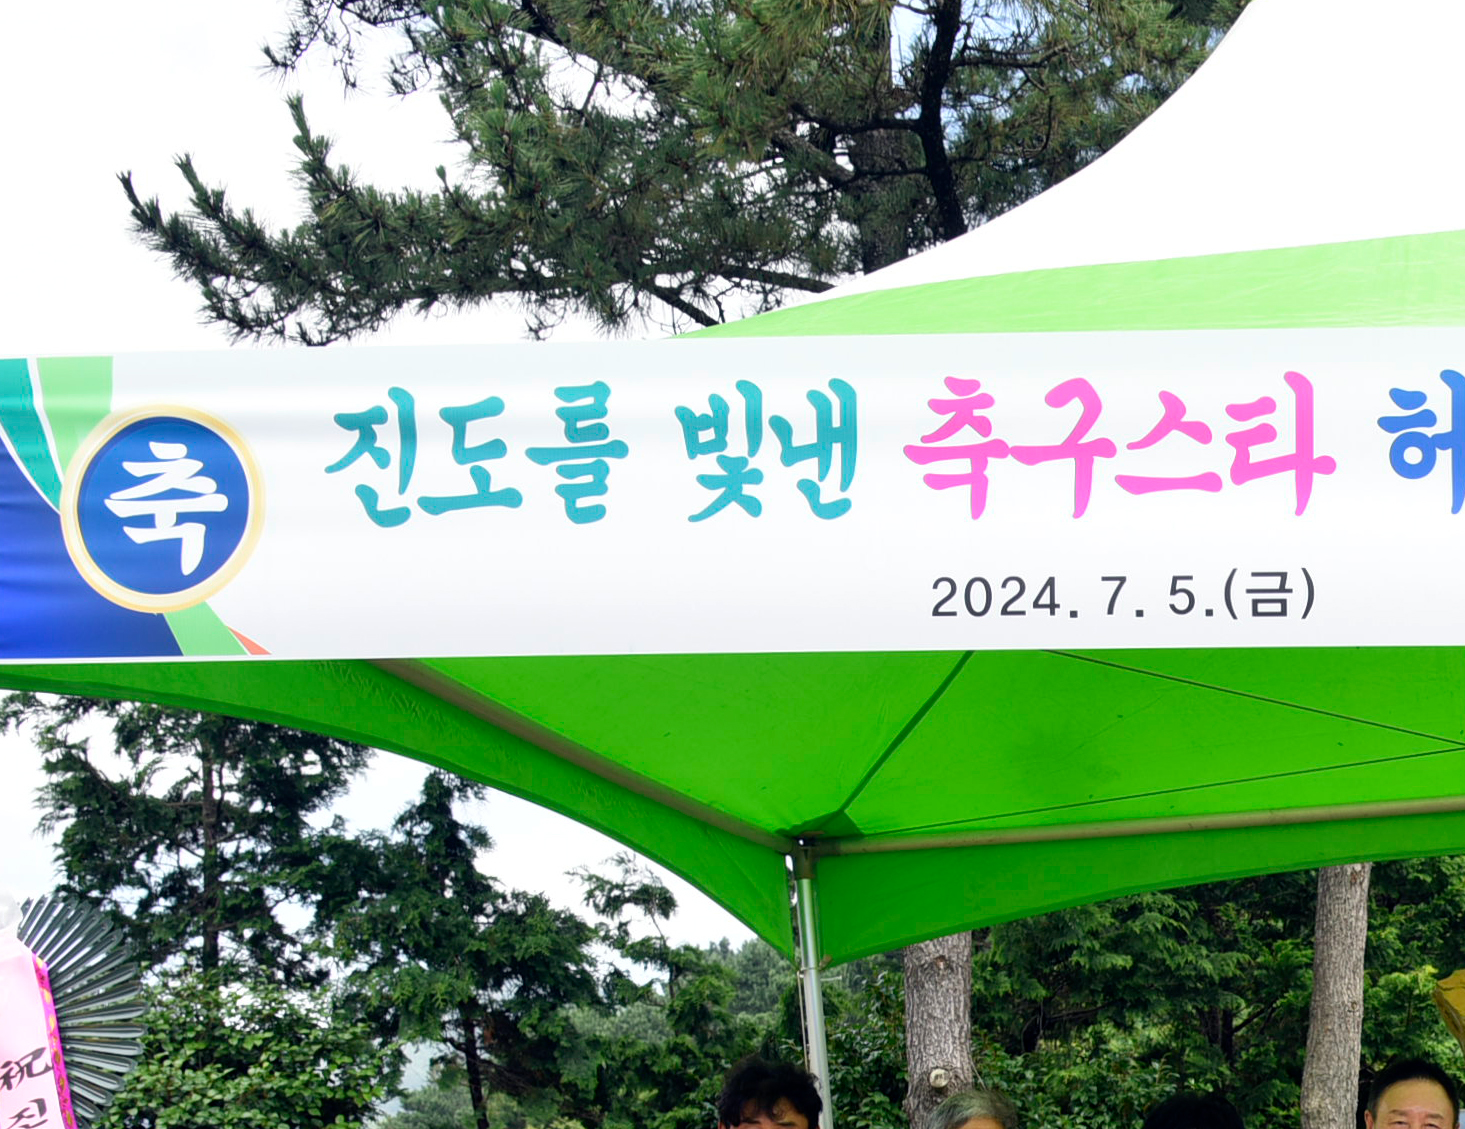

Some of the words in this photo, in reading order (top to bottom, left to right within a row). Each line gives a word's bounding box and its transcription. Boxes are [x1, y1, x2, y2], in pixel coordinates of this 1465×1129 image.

[324, 379, 629, 528] 진도를
[674, 376, 859, 524] 빛낸
[902, 369, 1338, 521] 축구스타
[104, 441, 228, 576] 축
[931, 576, 1079, 619] 2024.
[1101, 576, 1144, 618] 7.
[1168, 567, 1316, 620] 5.(금)
[0, 1047, 54, 1091] 祝
